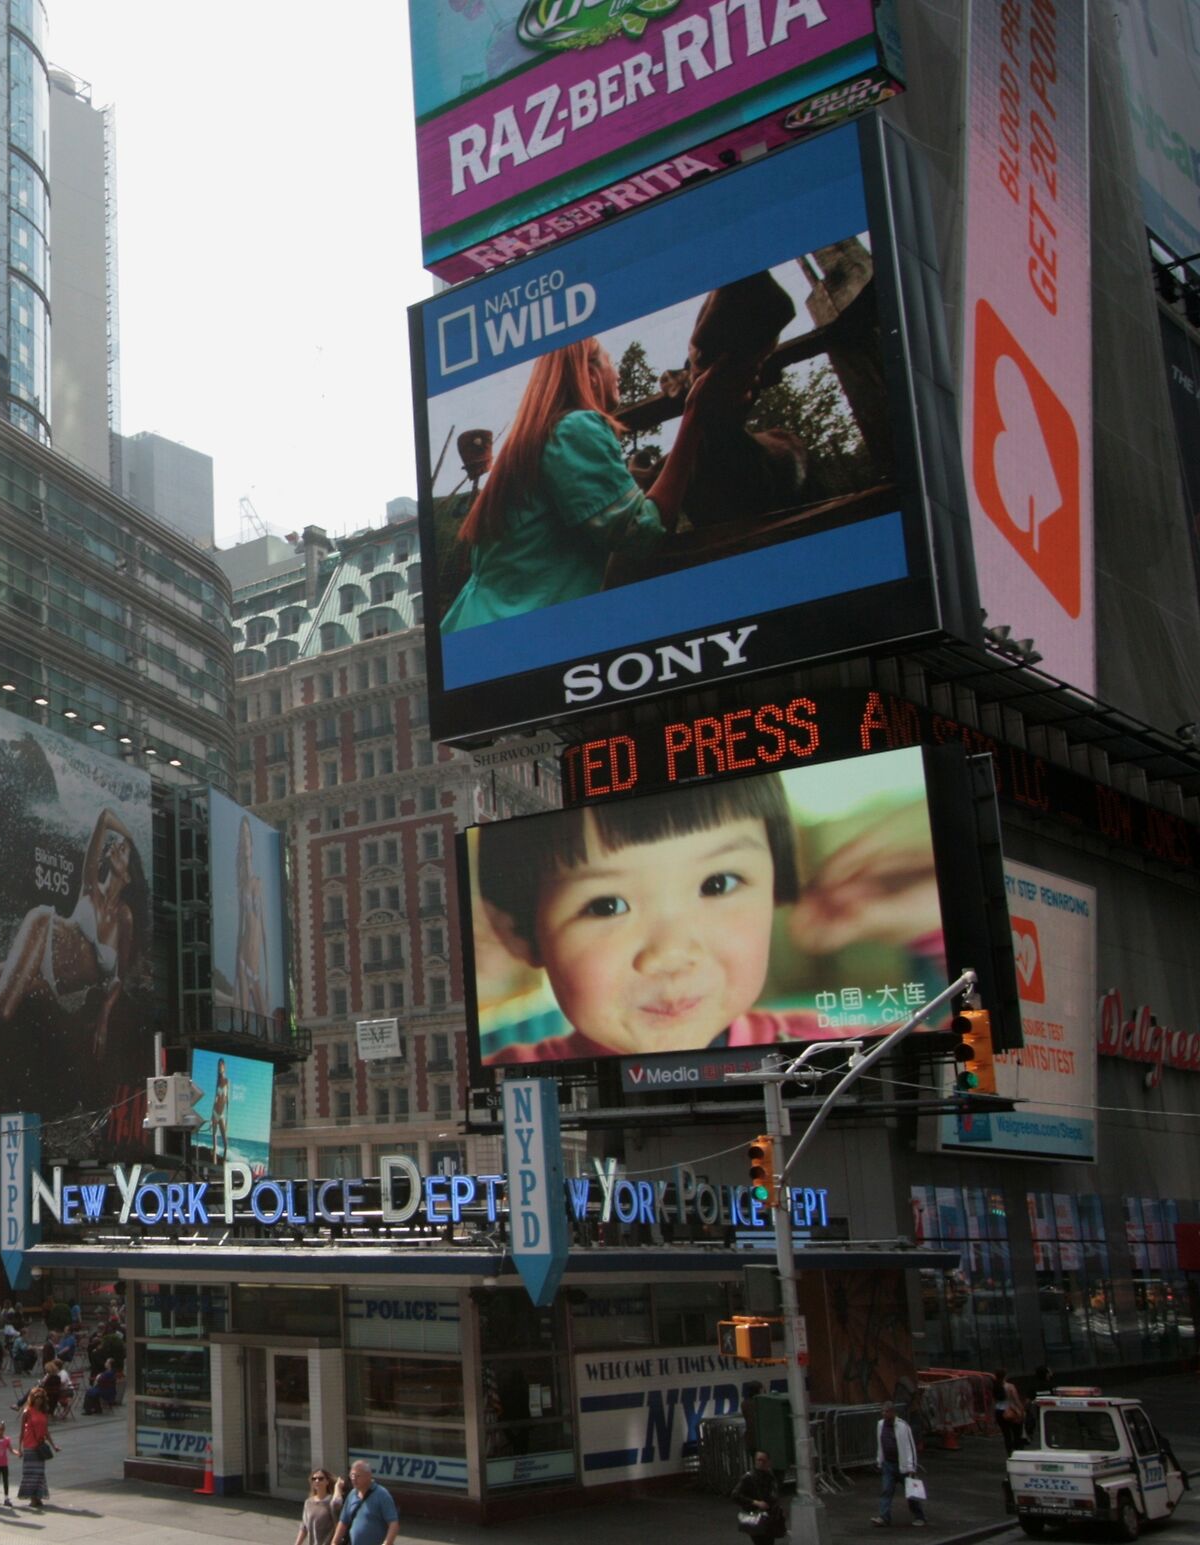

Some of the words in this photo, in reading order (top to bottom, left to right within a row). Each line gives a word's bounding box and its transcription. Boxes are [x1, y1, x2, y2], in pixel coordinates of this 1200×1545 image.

[449, 0, 829, 196] RAZ-BER-RITA
[795, 80, 888, 125] LIGHT
[810, 78, 875, 110] BUD
[999, 63, 1020, 205] BLOOD
[1030, 109, 1057, 200] 20
[462, 154, 718, 268] RAZ-BER-RITA
[1029, 183, 1057, 316] GET
[484, 285, 522, 318] NAT
[524, 269, 565, 301] GEO
[484, 282, 597, 357] WILD
[563, 624, 758, 704] SONY
[472, 742, 552, 768] SHERWOOD
[664, 697, 820, 781] PRESS
[35, 847, 58, 867] Bikini
[58, 854, 75, 875] Top
[35, 863, 71, 896] $4.95
[1018, 879, 1038, 902] STEP
[1040, 886, 1090, 918] REWARDING
[1047, 1022, 1064, 1041] TEST
[646, 1066, 700, 1084] Media
[5, 1120, 19, 1246] NYPD
[512, 1086, 542, 1249] NYPD
[113, 1163, 209, 1225] YORK
[224, 1161, 365, 1225] POLICE
[365, 1300, 438, 1322] POLICE
[585, 1360, 652, 1381] WELCOME
[659, 1358, 672, 1377] TO
[678, 1355, 715, 1376] TIMES
[160, 1432, 208, 1453] NYPD
[641, 1382, 762, 1464] NYP
[379, 1455, 437, 1480] NYPD
[1024, 1483, 1080, 1492] POLICE
[1030, 1477, 1071, 1485] NYPD
